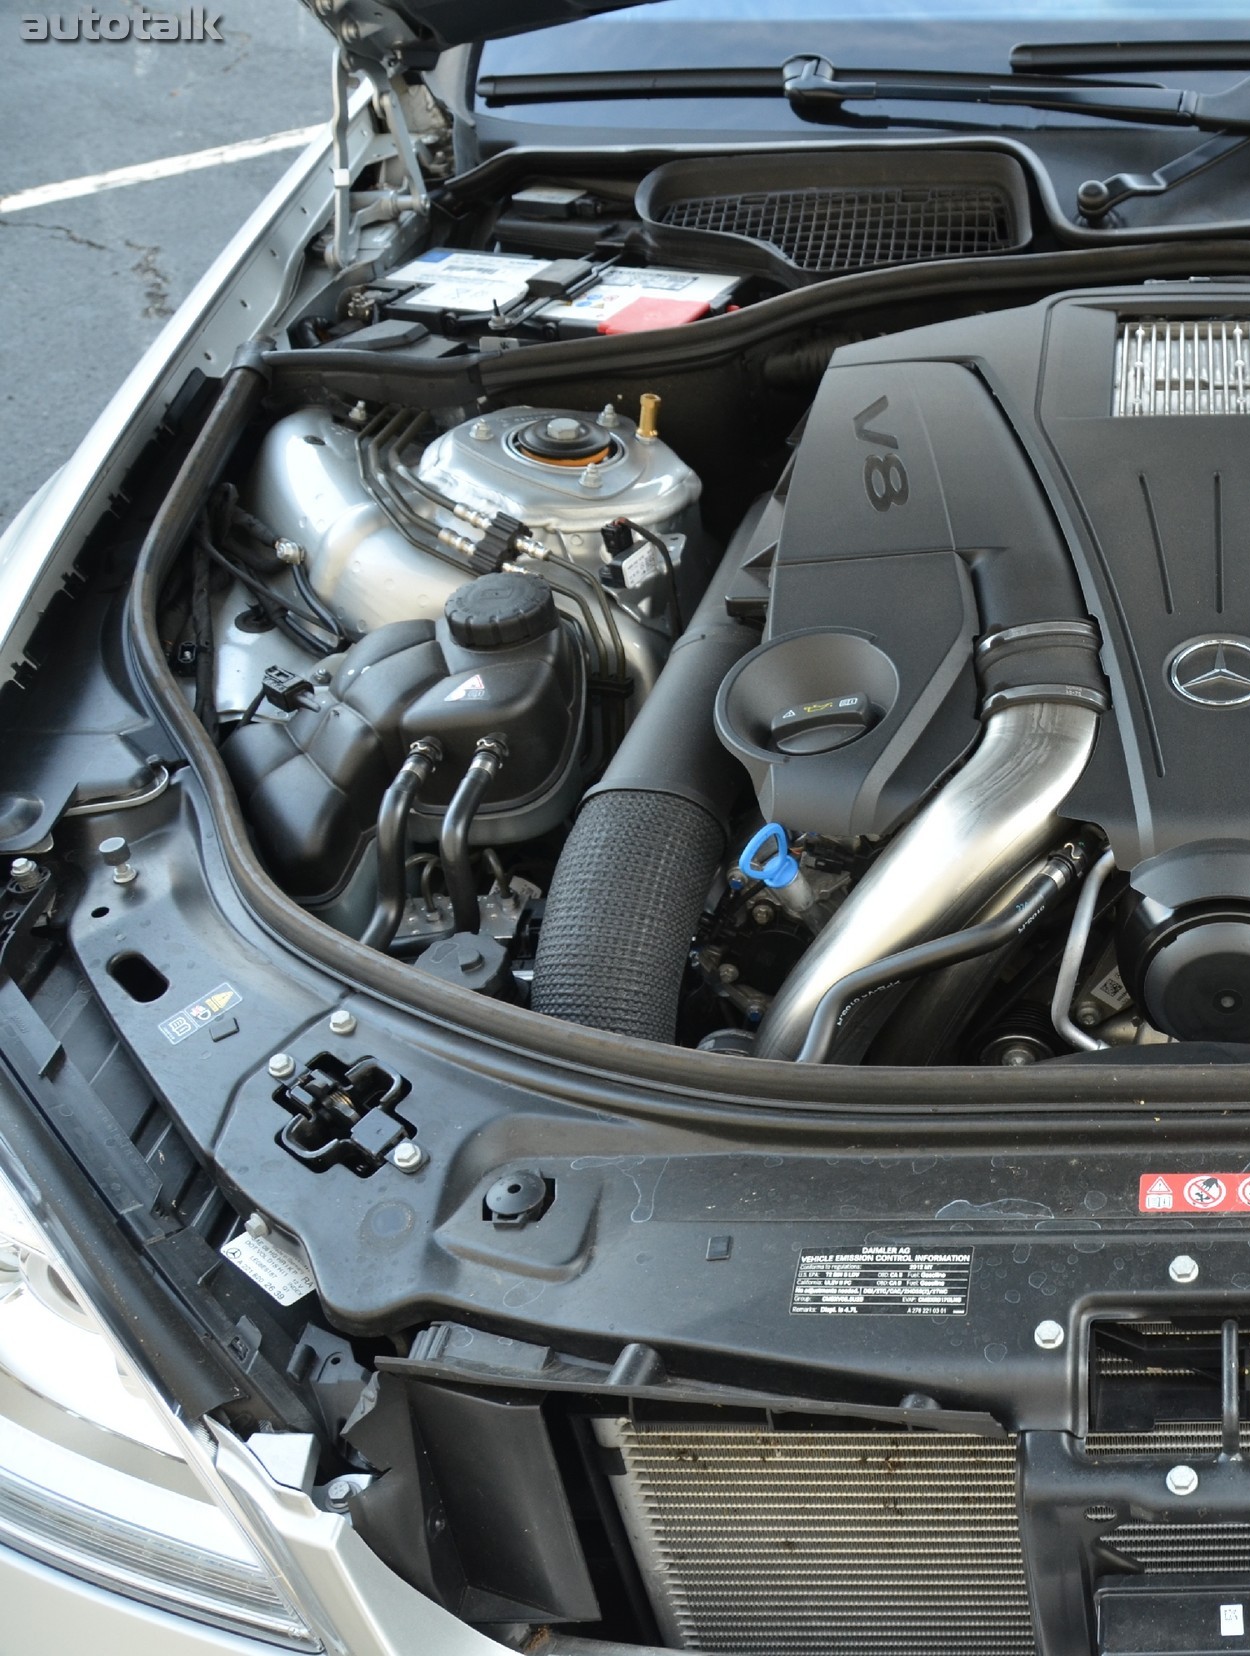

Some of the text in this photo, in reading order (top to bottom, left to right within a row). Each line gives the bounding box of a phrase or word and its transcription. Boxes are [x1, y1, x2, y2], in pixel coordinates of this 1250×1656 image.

[852, 394, 909, 512] V8
[242, 1263, 252, 1274] 221
[264, 1282, 275, 1292] 26
[274, 1290, 285, 1300] 39
